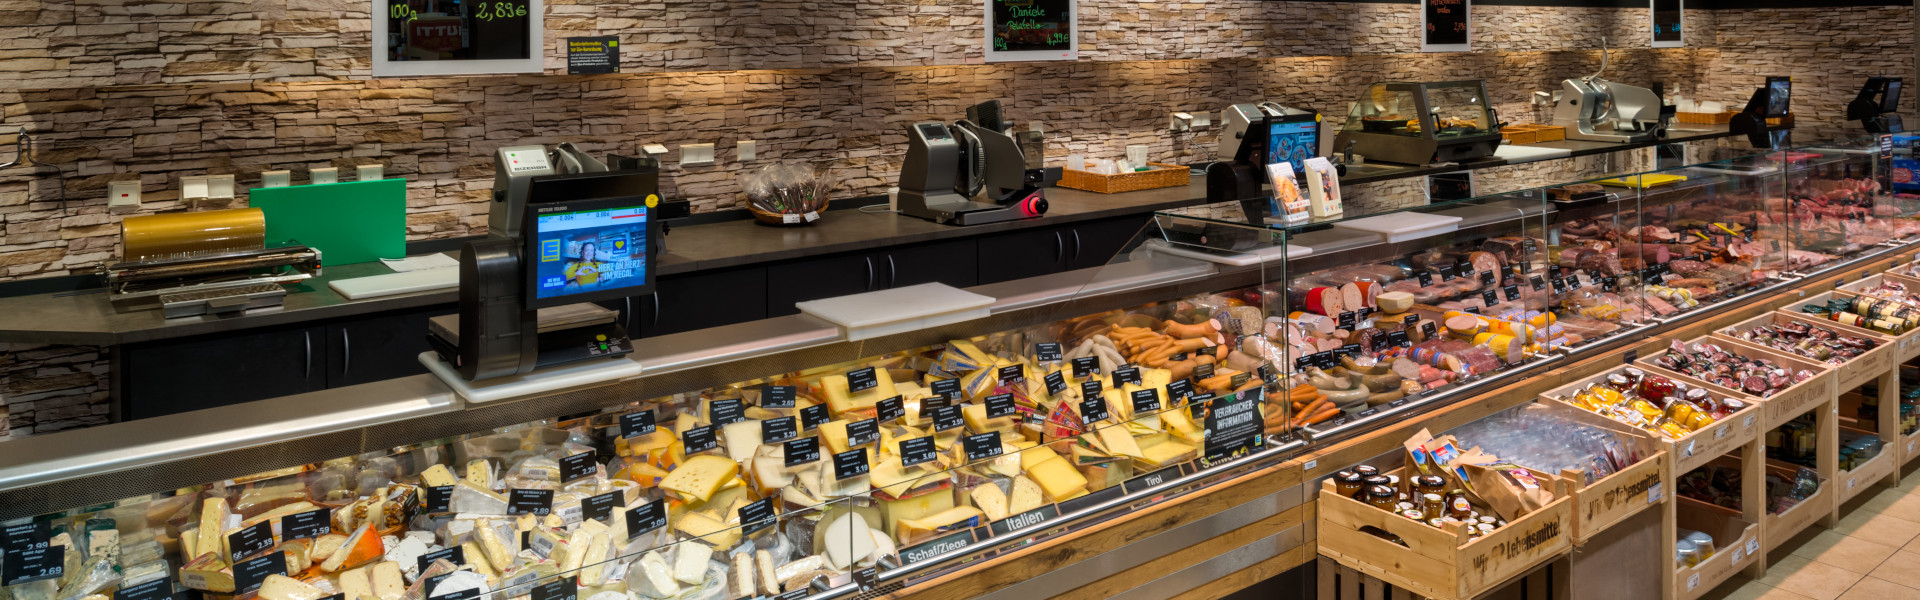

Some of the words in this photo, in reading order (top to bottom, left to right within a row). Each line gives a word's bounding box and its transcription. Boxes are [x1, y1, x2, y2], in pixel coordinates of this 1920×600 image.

[475, 2, 528, 21] 2,89€
[1214, 400, 1254, 419] VERBRAUCHER-
[1216, 411, 1253, 430] INFORMATION
[805, 452, 819, 460] 2.99
[922, 451, 937, 460] 3.69
[582, 466, 596, 475] 2.29
[855, 464, 868, 473] 3.19
[1144, 475, 1163, 487] Tirol
[533, 507, 550, 515] 2.89
[650, 517, 665, 529] 2.09
[1005, 511, 1044, 531] Italien
[311, 526, 330, 536] 2.59
[27, 541, 49, 551] 2.99
[257, 537, 273, 550] 2.39
[40, 566, 62, 577] 2.69
